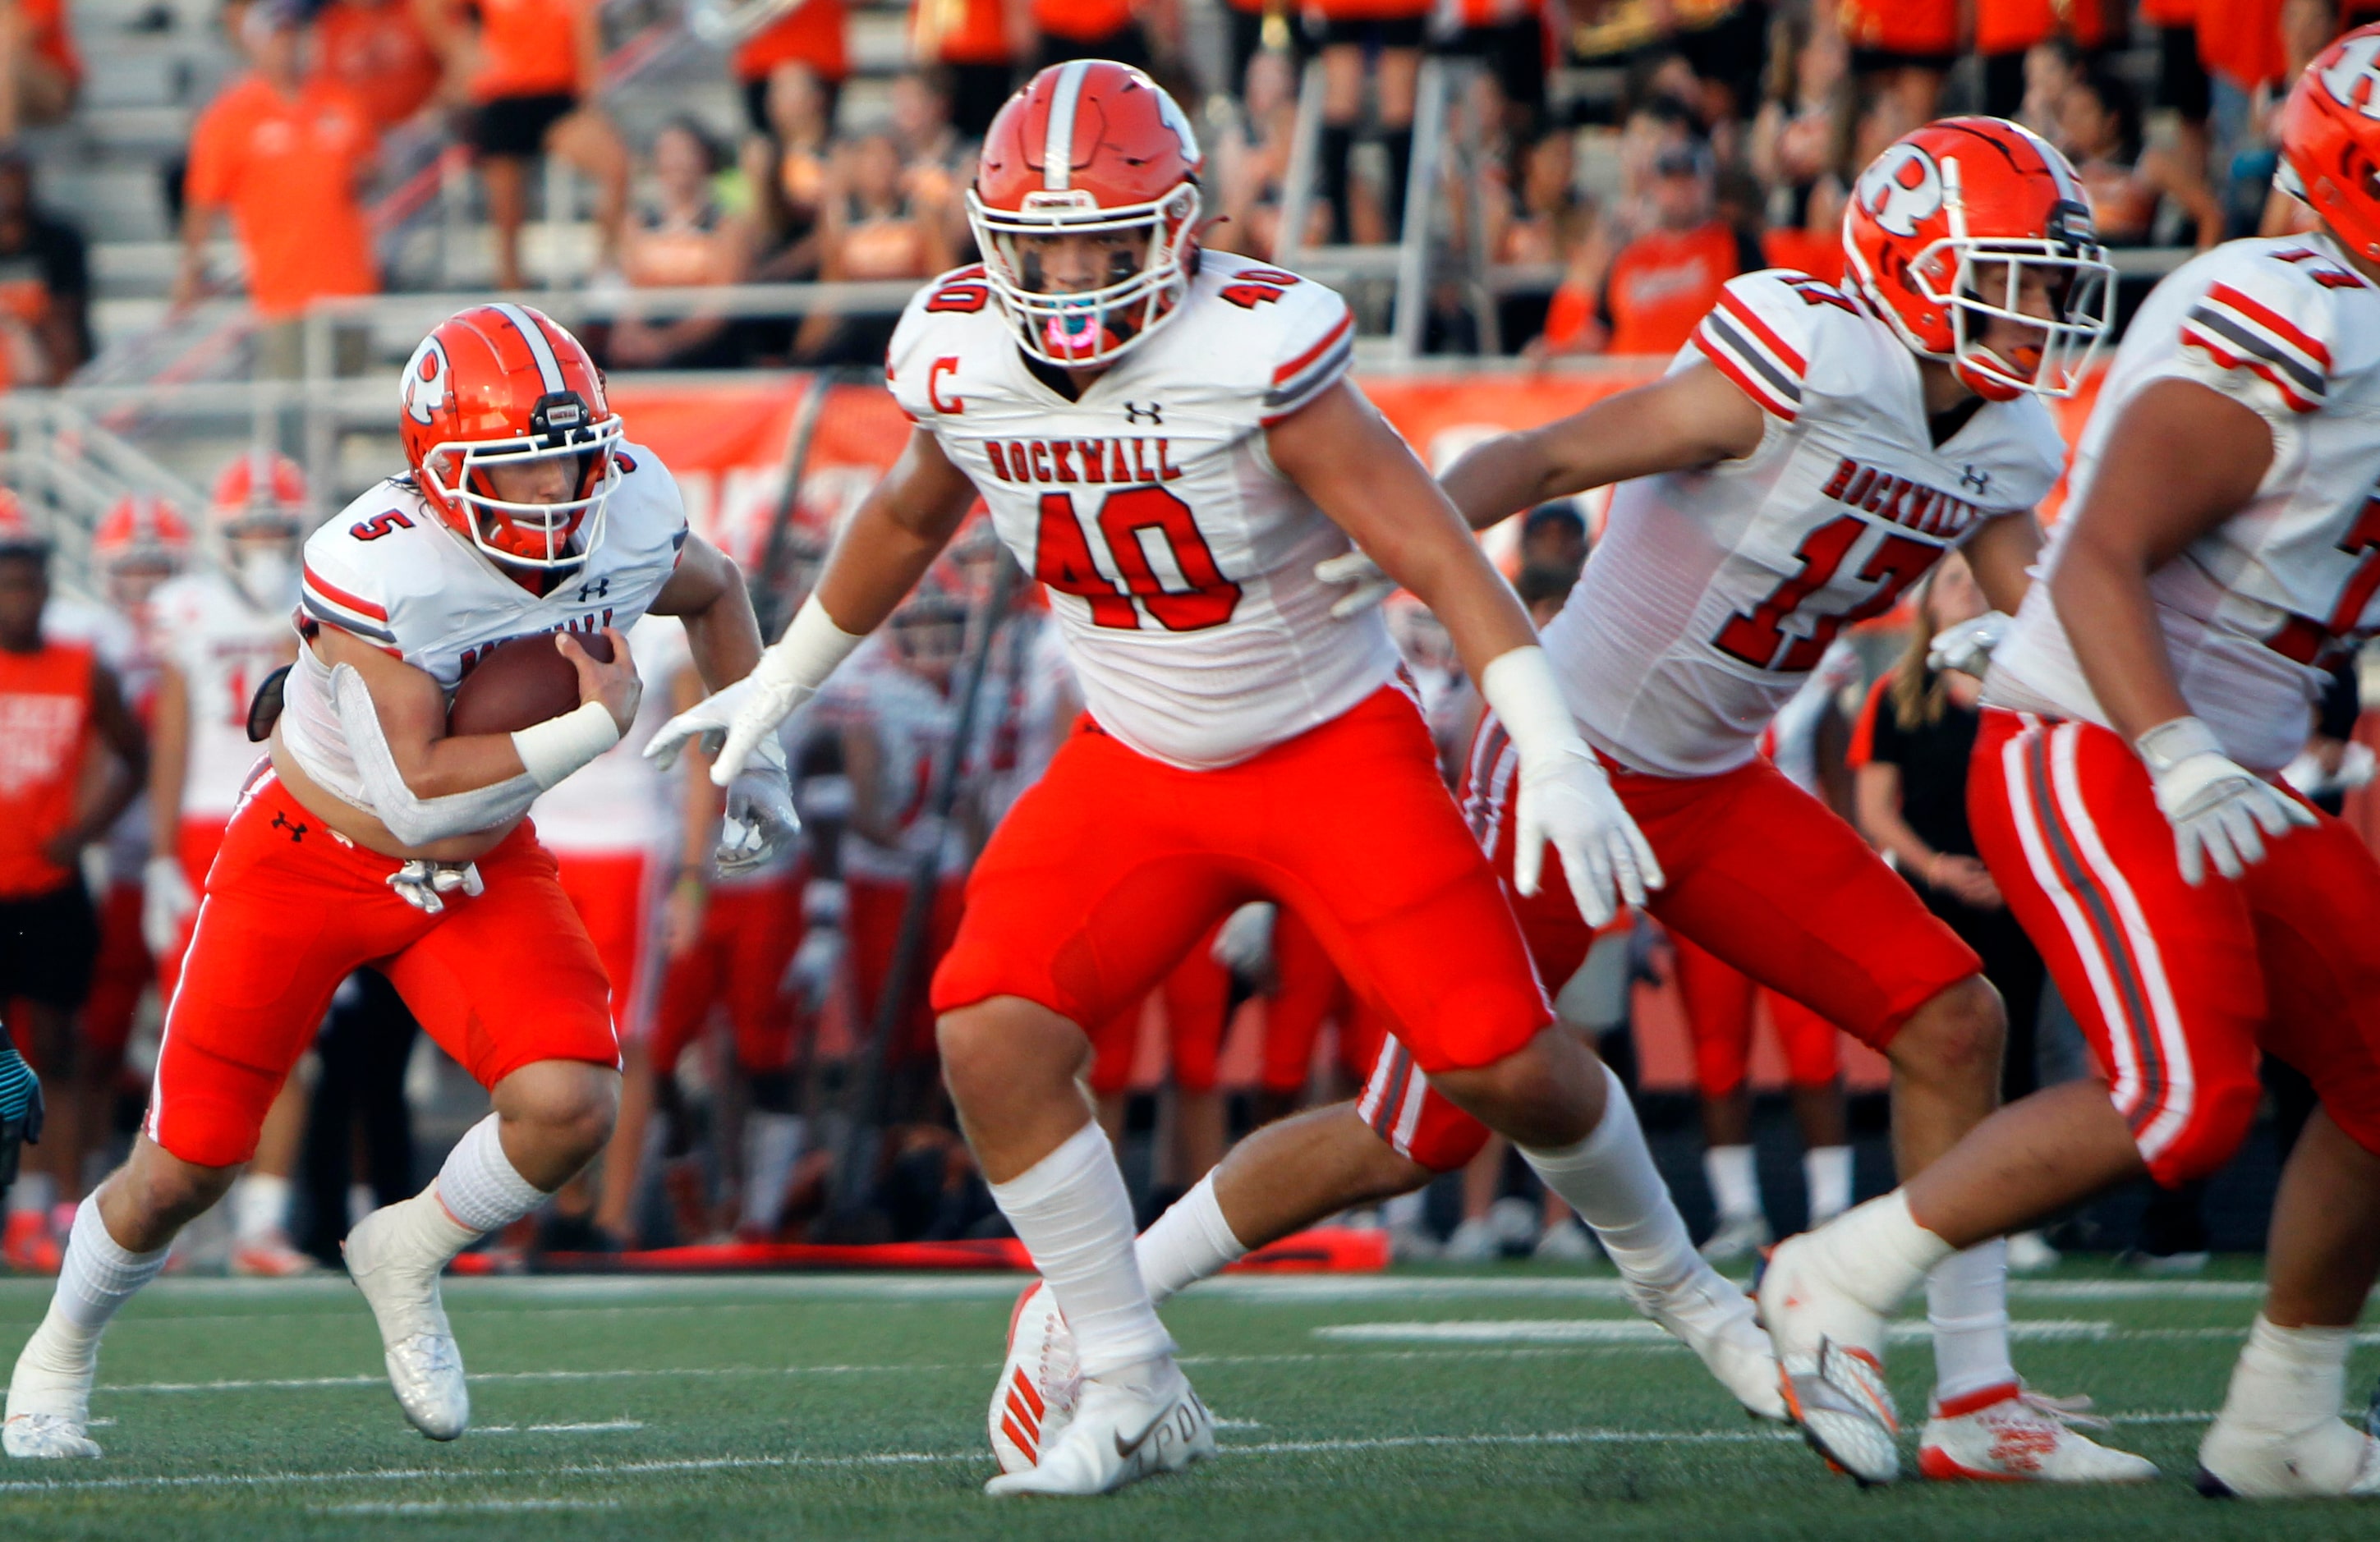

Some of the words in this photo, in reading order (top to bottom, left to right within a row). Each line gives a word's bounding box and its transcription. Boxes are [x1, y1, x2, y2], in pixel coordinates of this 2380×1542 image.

[1859, 142, 1942, 237] R
[1219, 268, 1301, 310] 40
[929, 357, 964, 414] C
[985, 438, 1183, 483] ROCKWALL
[349, 507, 417, 541] 5
[1033, 483, 1243, 631] 40
[1711, 512, 1946, 672] 17
